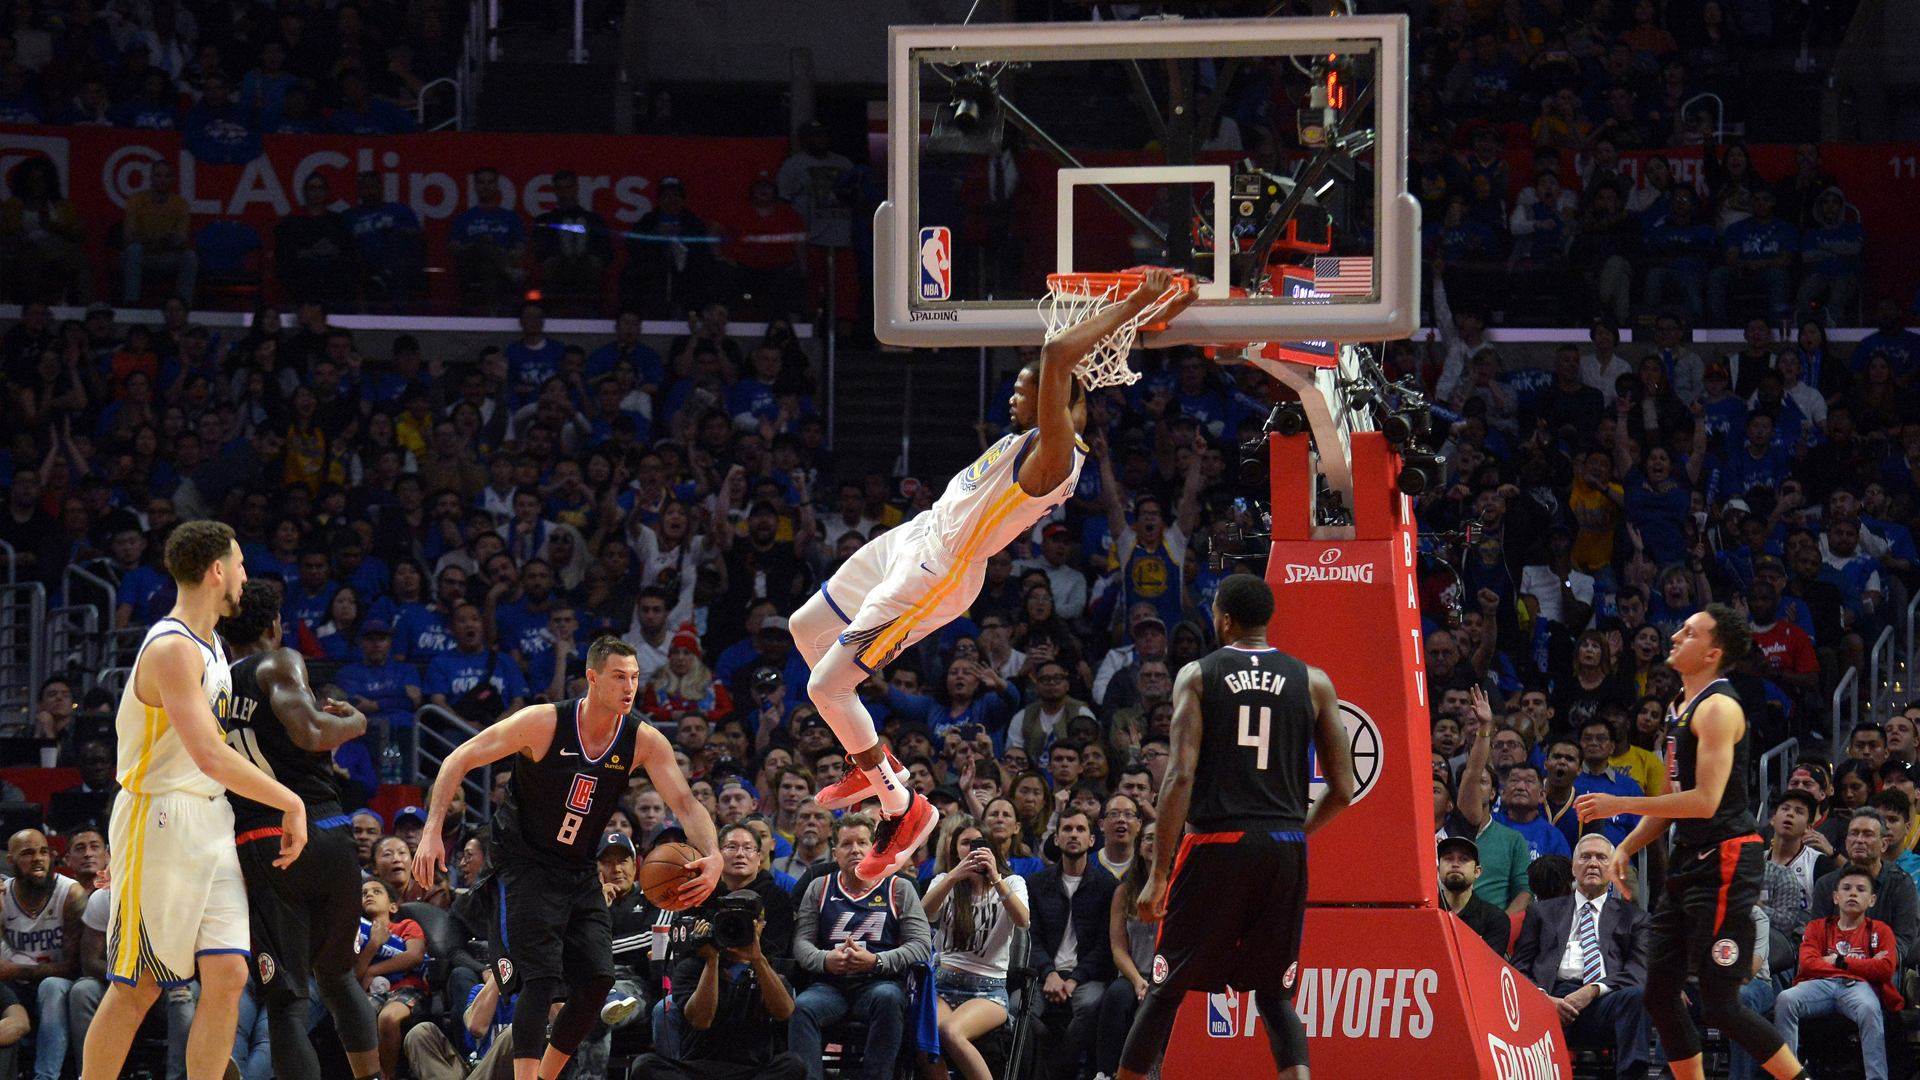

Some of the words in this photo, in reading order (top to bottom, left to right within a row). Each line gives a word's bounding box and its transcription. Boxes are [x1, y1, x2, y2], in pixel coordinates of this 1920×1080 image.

[924, 283, 939, 297] NBA
[909, 310, 958, 322] SPALDING
[1284, 563, 1374, 584] SPALDING
[1224, 669, 1286, 696] GREEN
[218, 699, 226, 719] 11
[1237, 705, 1271, 770] 4
[604, 762, 625, 771] bumble
[556, 812, 583, 846] 8
[608, 833, 620, 844] C
[829, 911, 888, 942] LA
[1244, 967, 1439, 1040] AYOFFS
[1212, 1021, 1227, 1034] NBA
